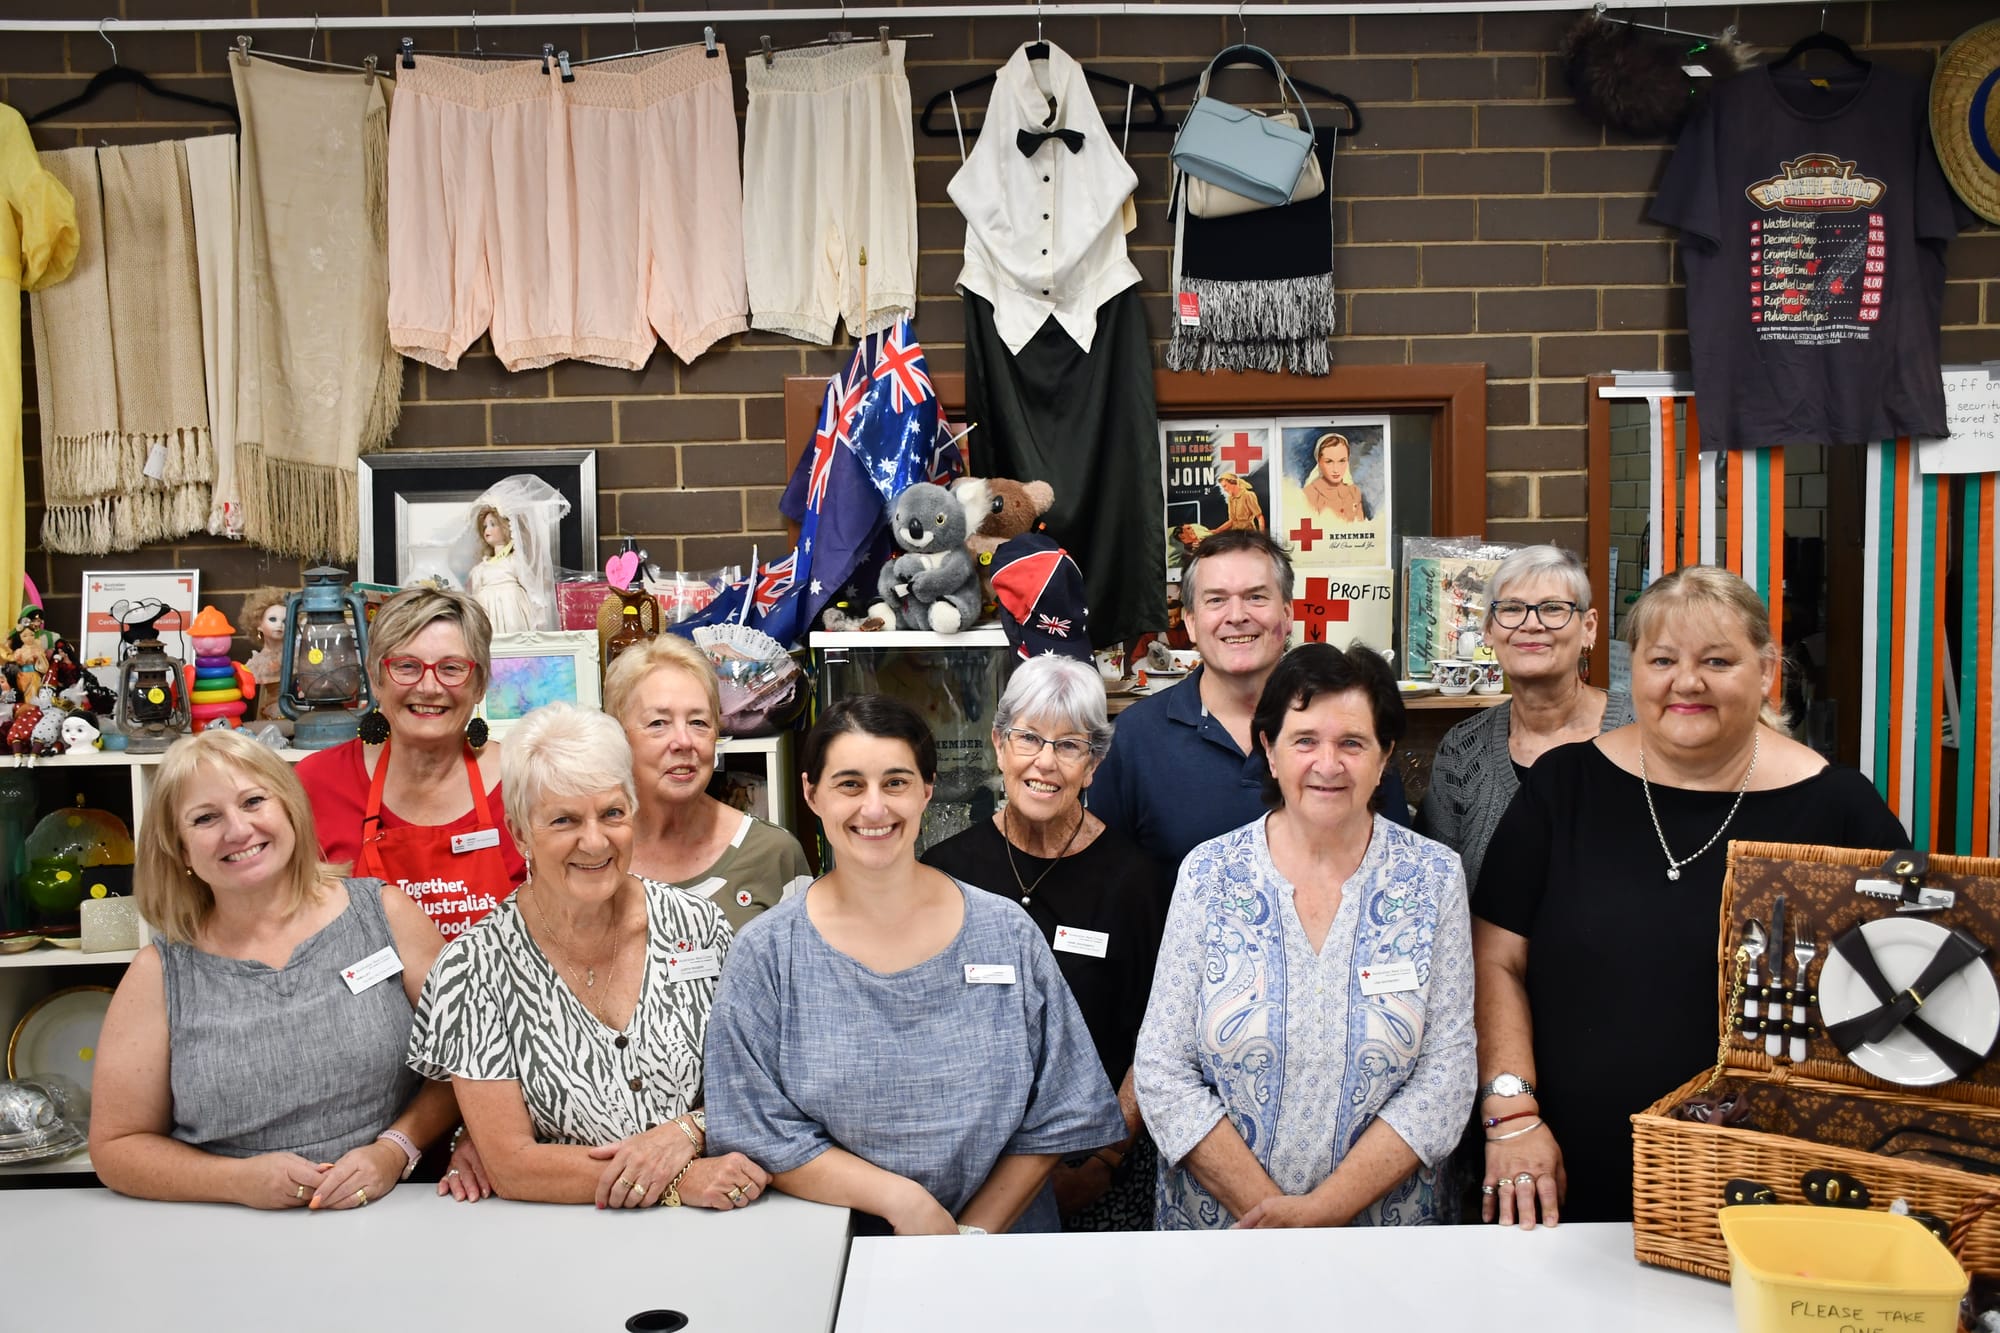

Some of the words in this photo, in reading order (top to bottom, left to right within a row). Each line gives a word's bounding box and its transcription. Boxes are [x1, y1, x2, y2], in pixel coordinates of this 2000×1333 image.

[1763, 177, 1824, 201] ROADKILL
[1831, 178, 1872, 199] GRILL
[1763, 217, 1791, 229] Wasted
[1763, 234, 1800, 245] Decimated
[1800, 234, 1817, 248] Dingo
[1763, 249, 1798, 262] Crumpled
[1799, 249, 1815, 260] Koala
[1867, 247, 1885, 257] $8.50
[1763, 266, 1795, 277] Expired
[1866, 262, 1883, 272] $8.50
[1763, 280, 1796, 291] Levelled
[1763, 294, 1799, 307] Ruptured
[1862, 293, 1881, 304] $8.95
[1859, 309, 1879, 319] $5.90
[1947, 413, 1985, 424] stered
[1973, 428, 1994, 439] this
[1170, 445, 1186, 454] RED
[1189, 445, 1214, 454] CROSS
[1170, 467, 1215, 487] JOIN
[1329, 532, 1375, 540] REMEMBER
[1330, 582, 1391, 600] PROFITS
[1418, 567, 1437, 625] Journal
[1304, 603, 1325, 615] TO
[1415, 626, 1434, 665] Home
[396, 877, 468, 899] Together,
[435, 916, 471, 935] lood
[1790, 1300, 1865, 1321] PLEASE
[1877, 1311, 1925, 1323] TAKE
